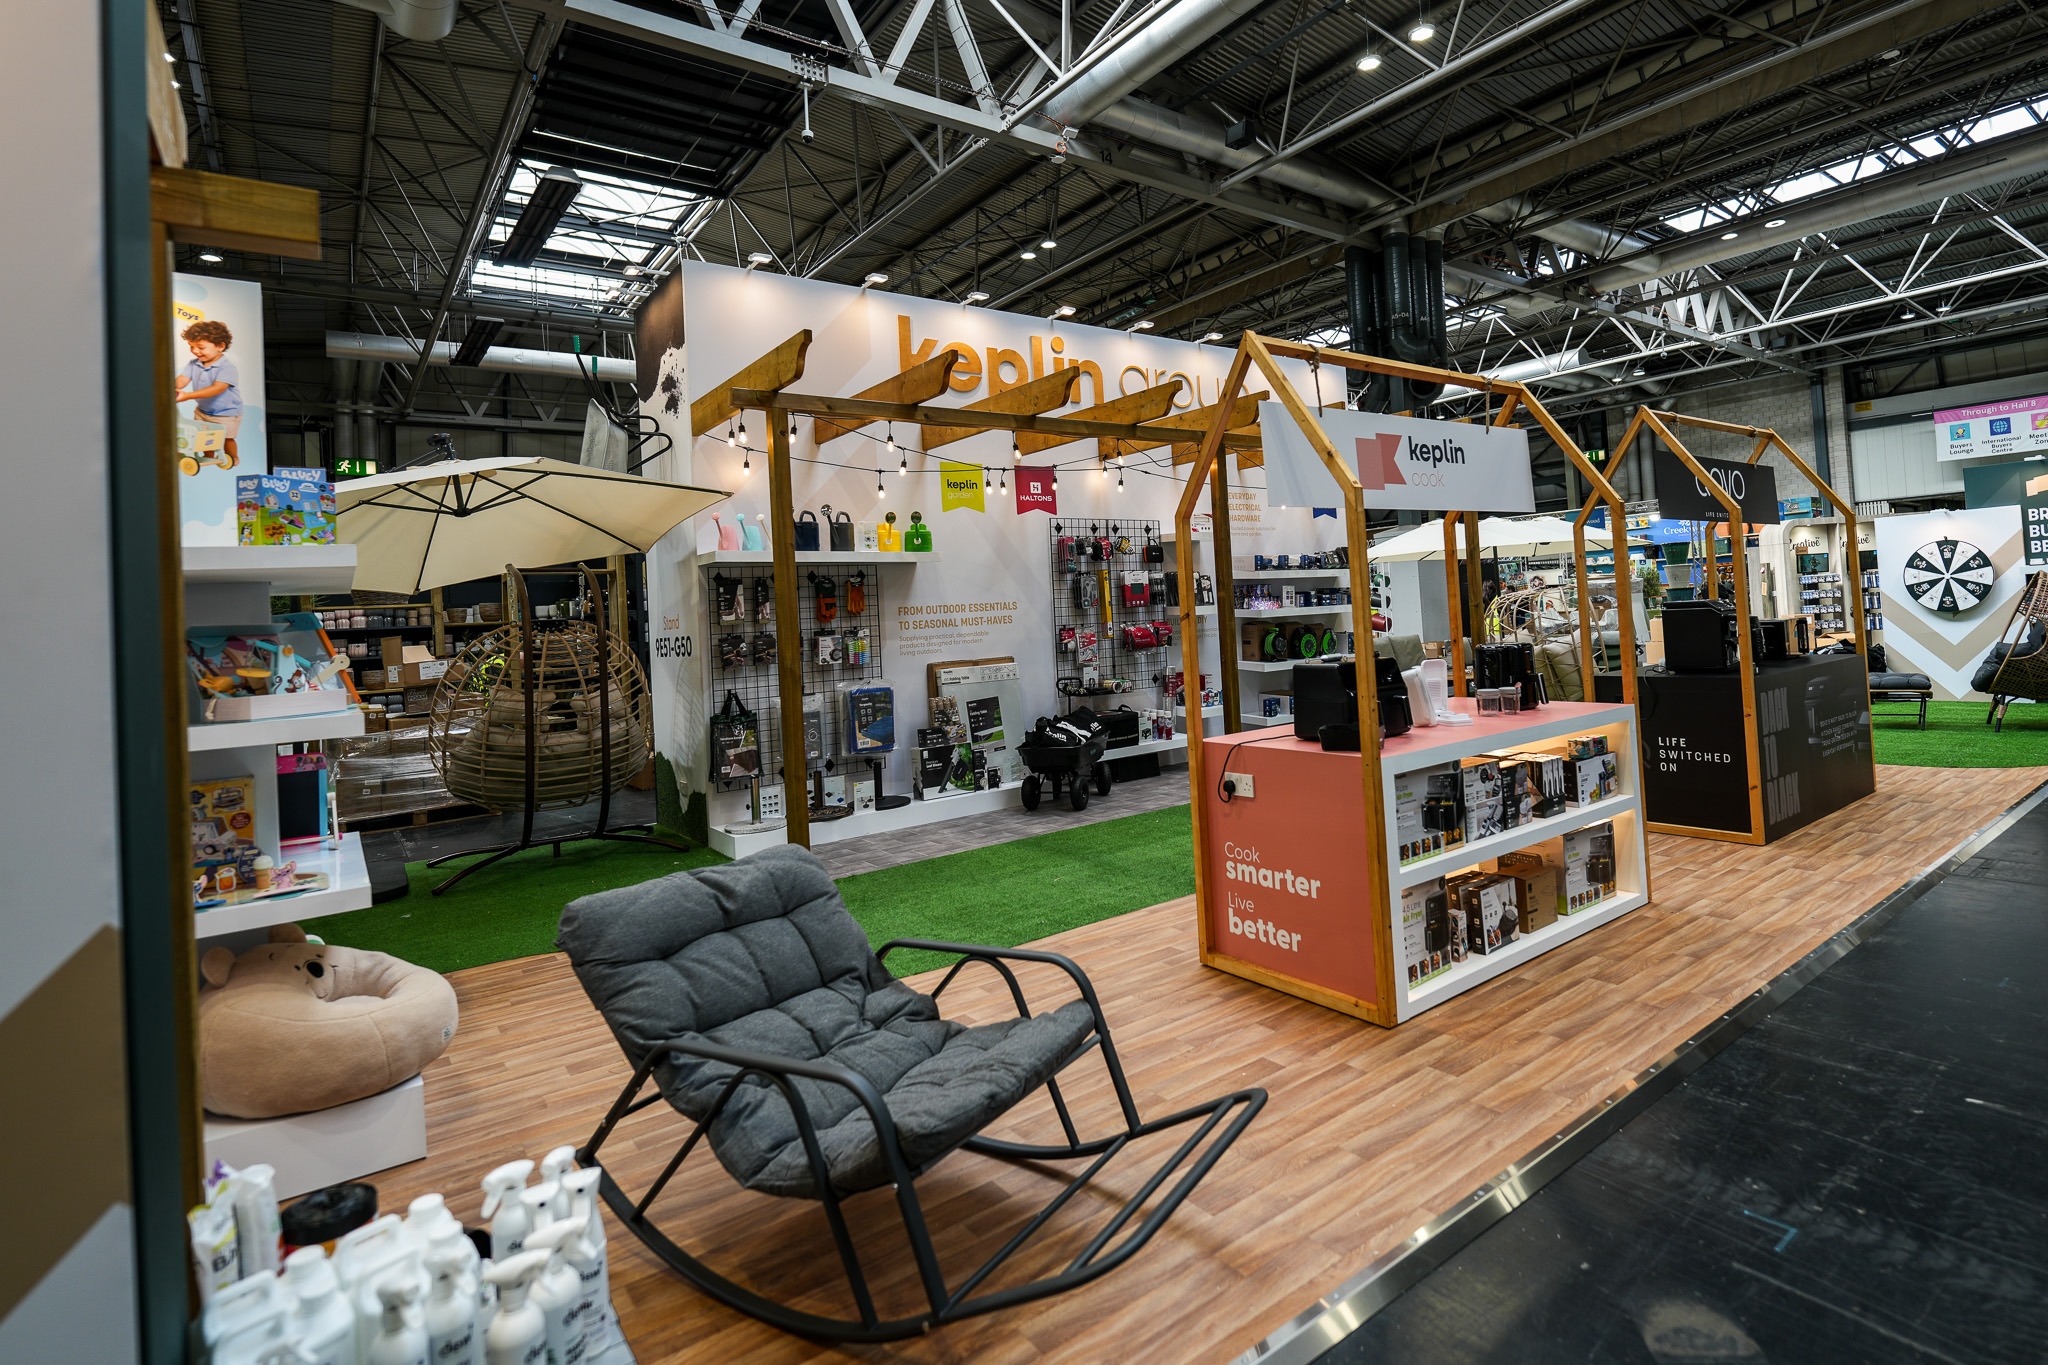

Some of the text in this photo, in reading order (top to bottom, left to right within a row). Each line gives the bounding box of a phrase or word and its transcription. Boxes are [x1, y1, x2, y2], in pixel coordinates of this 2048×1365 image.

[1100, 150, 1113, 164] 14
[177, 307, 200, 321] Toys
[897, 314, 1104, 405] keplin
[1961, 406, 1997, 417] Through
[2011, 401, 2028, 410] Hall
[1982, 436, 2022, 445] International
[2029, 432, 2048, 440] Meet
[1408, 436, 1466, 468] keplin
[1950, 442, 1972, 450] Buyers
[946, 478, 978, 491] keplin
[1412, 469, 1445, 488] cook
[947, 491, 974, 500] garden
[1228, 492, 1256, 500] EVERYDAY
[1230, 504, 1262, 512] ELECTRICAL
[2028, 507, 2048, 522] BR
[2029, 524, 2048, 538] BU
[2030, 540, 2048, 554] BE
[898, 601, 1018, 616] FROM OUTDOOR ESSENTIALS
[664, 614, 680, 630] Stand
[898, 615, 1013, 631] TO SEASONAL MUST-HAVES
[1198, 616, 1208, 624] DIY
[899, 630, 989, 644] Supplying practical, dependable
[656, 636, 692, 658] 9E51-G50
[900, 642, 926, 650] products
[926, 640, 953, 648] designed
[1760, 686, 1790, 736] BACK
[1658, 736, 1686, 747] LIFE
[1659, 749, 1731, 763] SWITCHED
[1763, 734, 1778, 780] TO
[1660, 762, 1677, 772] ON
[1766, 771, 1800, 826] BLACK
[1224, 842, 1260, 863] Cook
[1226, 860, 1321, 899] smarter
[1228, 891, 1254, 912] Live
[1228, 907, 1302, 952] better
